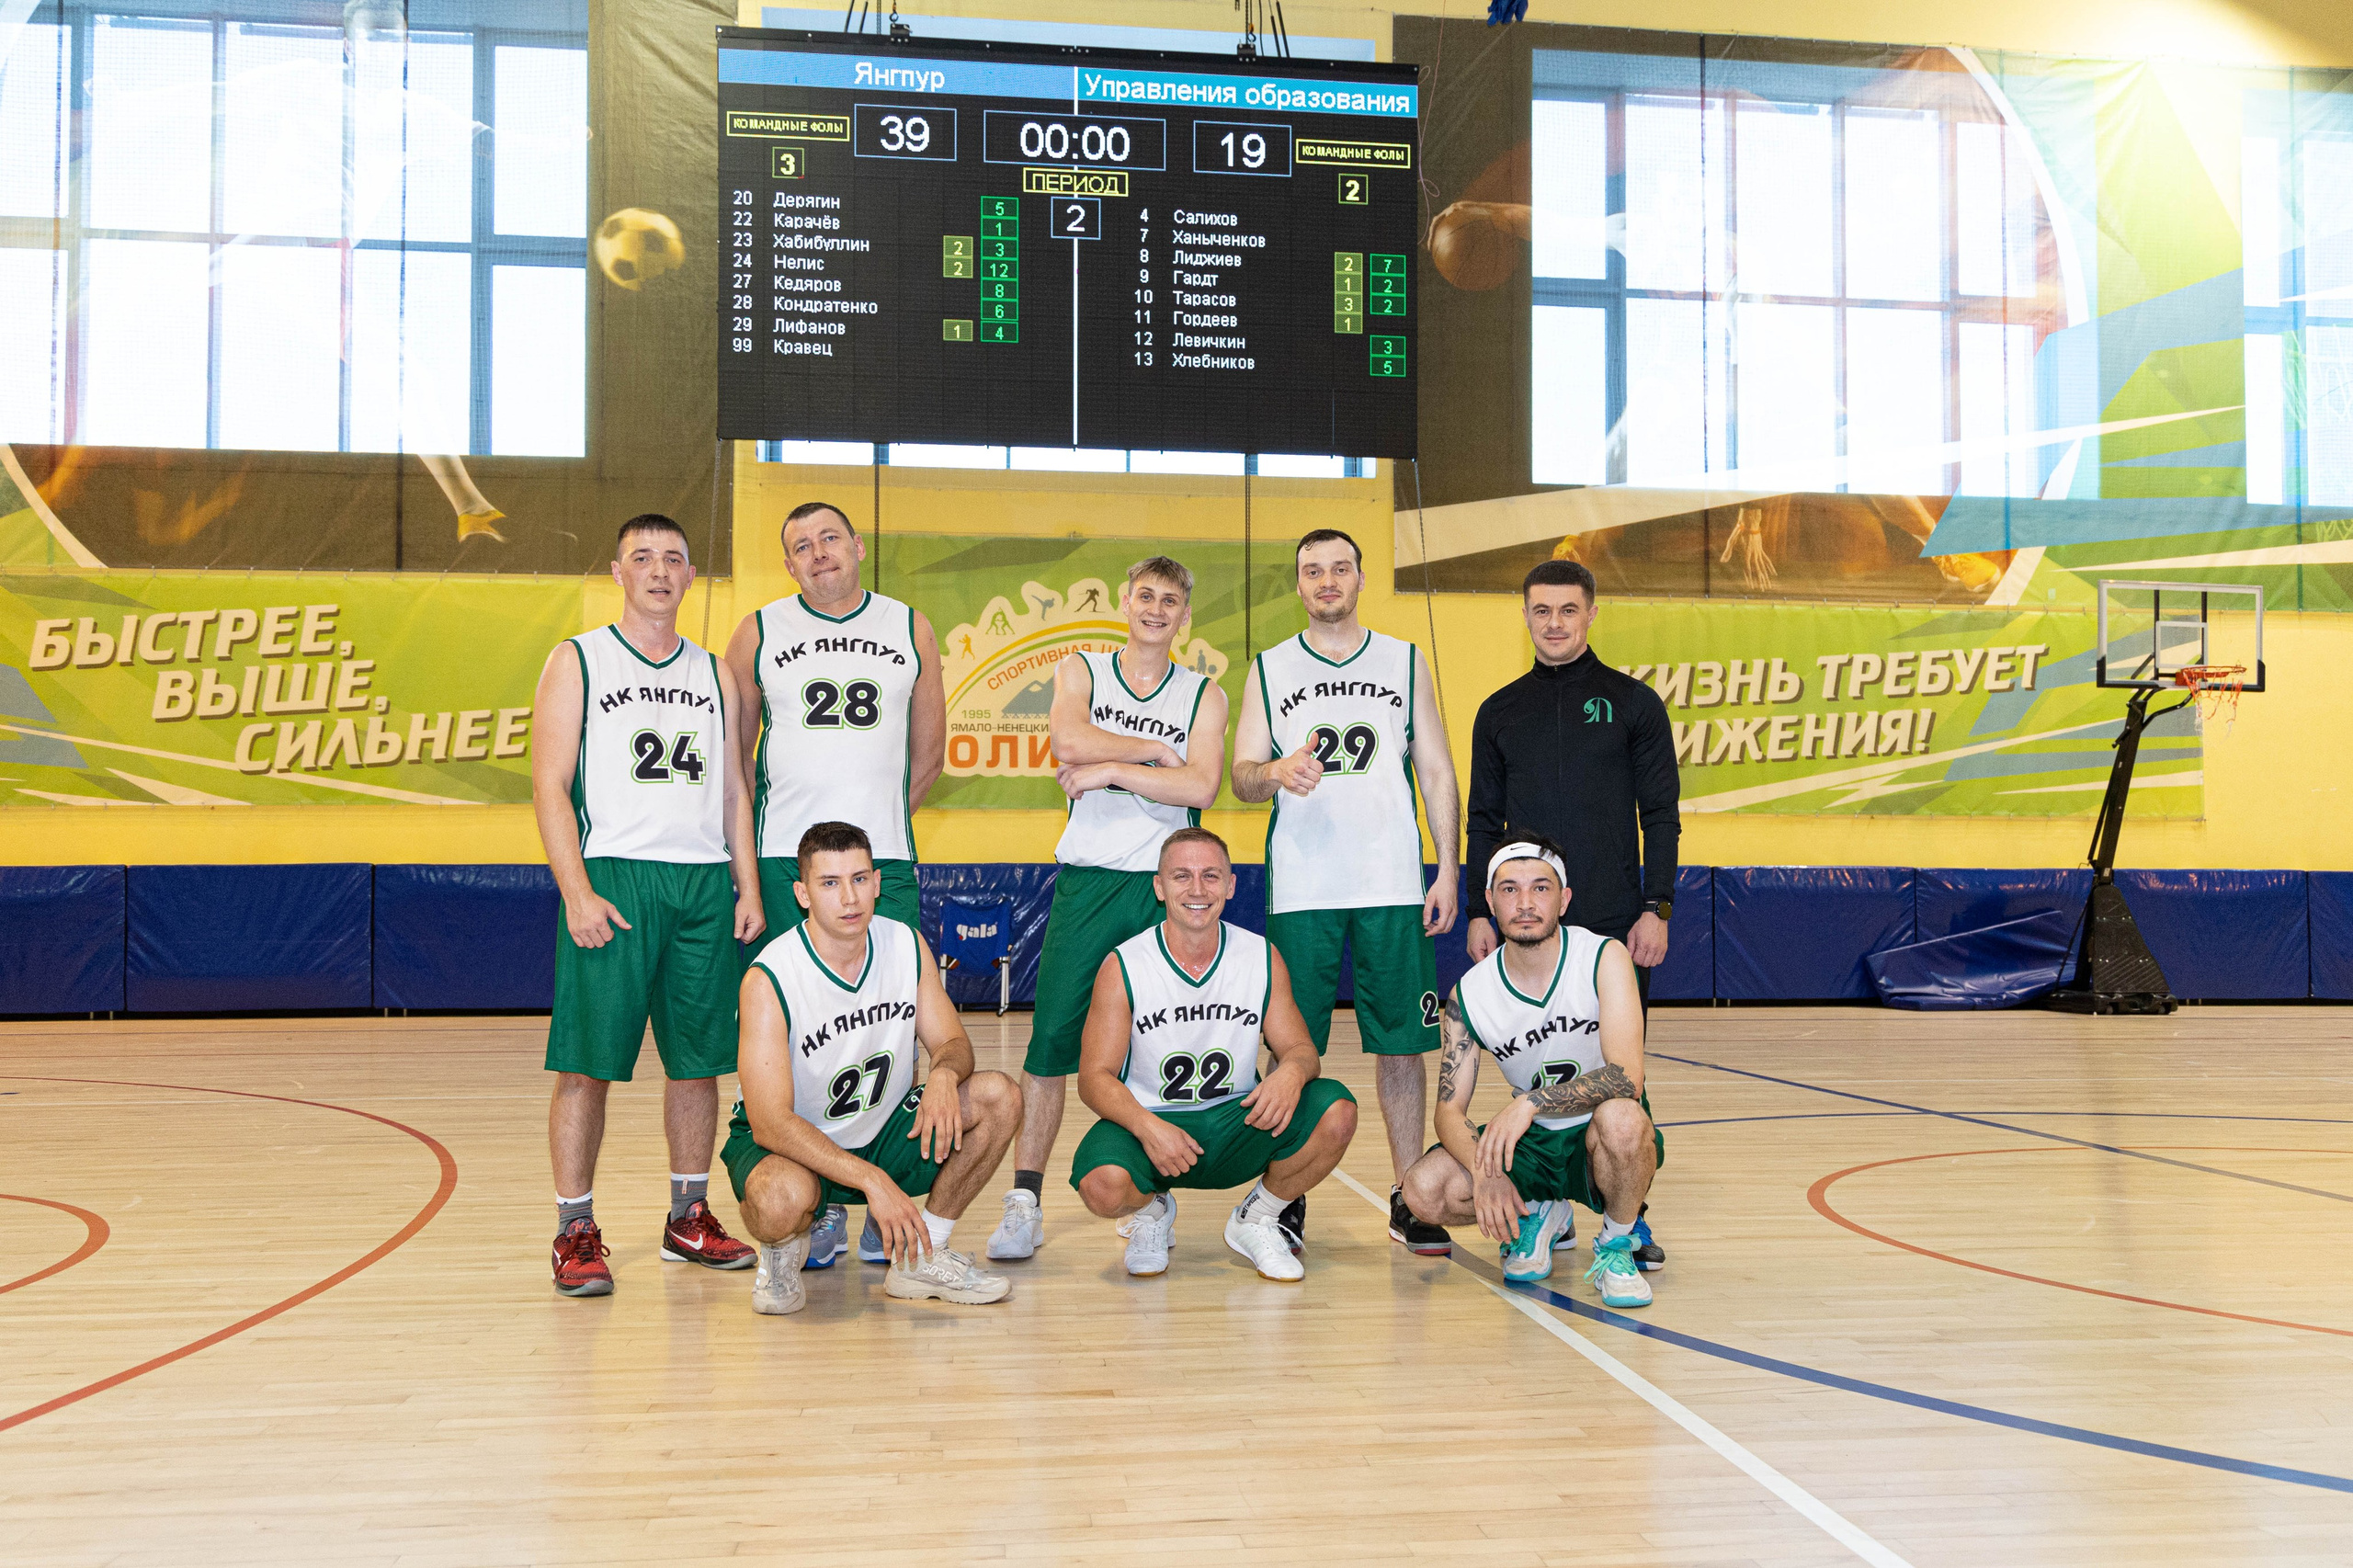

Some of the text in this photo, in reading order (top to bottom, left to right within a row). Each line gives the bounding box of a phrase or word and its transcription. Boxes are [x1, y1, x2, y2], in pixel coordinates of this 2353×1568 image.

[854, 62, 946, 92] Янгпур
[1085, 74, 1410, 113] Управления образования
[733, 117, 844, 133] КОМАНДНЫЕ ФОЛЫ
[880, 115, 930, 152] 39
[1019, 121, 1131, 162] 00:00
[1221, 132, 1267, 167] 19
[1302, 144, 1404, 161] КОМАНДНЫЕ ФОЛЫ
[779, 153, 796, 176] 3
[1031, 172, 1120, 194] ПЕРИОД
[1346, 179, 1360, 201] 2
[733, 190, 839, 209] 20 Дерягин
[995, 202, 1005, 216] 5
[1140, 208, 1238, 226] 4 Салихов
[733, 211, 840, 230] 22 Карачёв
[1066, 204, 1086, 233] 2
[995, 223, 1003, 236] 1
[1140, 228, 1266, 247] 7 Ханыченков
[733, 233, 870, 251] 23 Хабибуллин
[953, 241, 963, 256] 2
[995, 244, 1005, 257] 3
[733, 253, 825, 271] 24 Нелис
[1140, 249, 1242, 267] 8 Лиджиев
[1344, 256, 1353, 272] 2
[1383, 260, 1392, 273] 7
[953, 261, 963, 277] 2
[989, 265, 1008, 278] 12
[1140, 269, 1219, 287] 9 Гардт
[733, 274, 841, 292] 27 Кедяров
[995, 285, 1005, 298] 8
[1344, 277, 1351, 291] 1
[1383, 279, 1392, 293] 2
[733, 295, 878, 313] 28 Кондратенко
[1134, 290, 1236, 307] 10 Тарасов
[1344, 297, 1353, 312] 3
[1383, 300, 1392, 313] 2
[995, 305, 1005, 319] 6
[1134, 310, 1238, 328] 11 Гордеев
[733, 317, 846, 335] 29 Лифанов
[953, 324, 961, 339] 1
[994, 326, 1005, 340] 4
[1344, 317, 1350, 332] 1
[733, 338, 833, 357] 99 Кравец
[1134, 331, 1245, 349] 12 Левичкин
[1383, 340, 1392, 354] 3
[1134, 352, 1256, 369] 13 Хлебников
[1383, 360, 1392, 375] 5
[28, 604, 355, 672] БЫСТРЕЕ,
[774, 637, 907, 668] НК ЯНГПУР
[1816, 643, 2050, 701] ТРЕБУЕТ
[152, 659, 391, 722] ВЫШЕ,
[1279, 681, 1403, 717] НК ЯНГПУР
[599, 687, 633, 713] НК
[801, 677, 882, 730] 28
[961, 710, 992, 719] 1995
[950, 722, 1050, 733] ЯМАЛО-НЕНЕЦКИ
[234, 707, 533, 776] СИЛЬНЕЕ
[1672, 708, 1937, 768] ИЖЕНИЯ!
[630, 728, 707, 785] 24
[948, 734, 1060, 768] ОЛИ
[1306, 722, 1379, 777] 29
[956, 923, 998, 941] gala
[1136, 1003, 1259, 1035] НК ЯНГПУР
[801, 1001, 915, 1058] НК ЯНГПУР
[1491, 1037, 1522, 1062] НК
[1159, 1048, 1234, 1103] 22
[824, 1050, 894, 1120] 27
